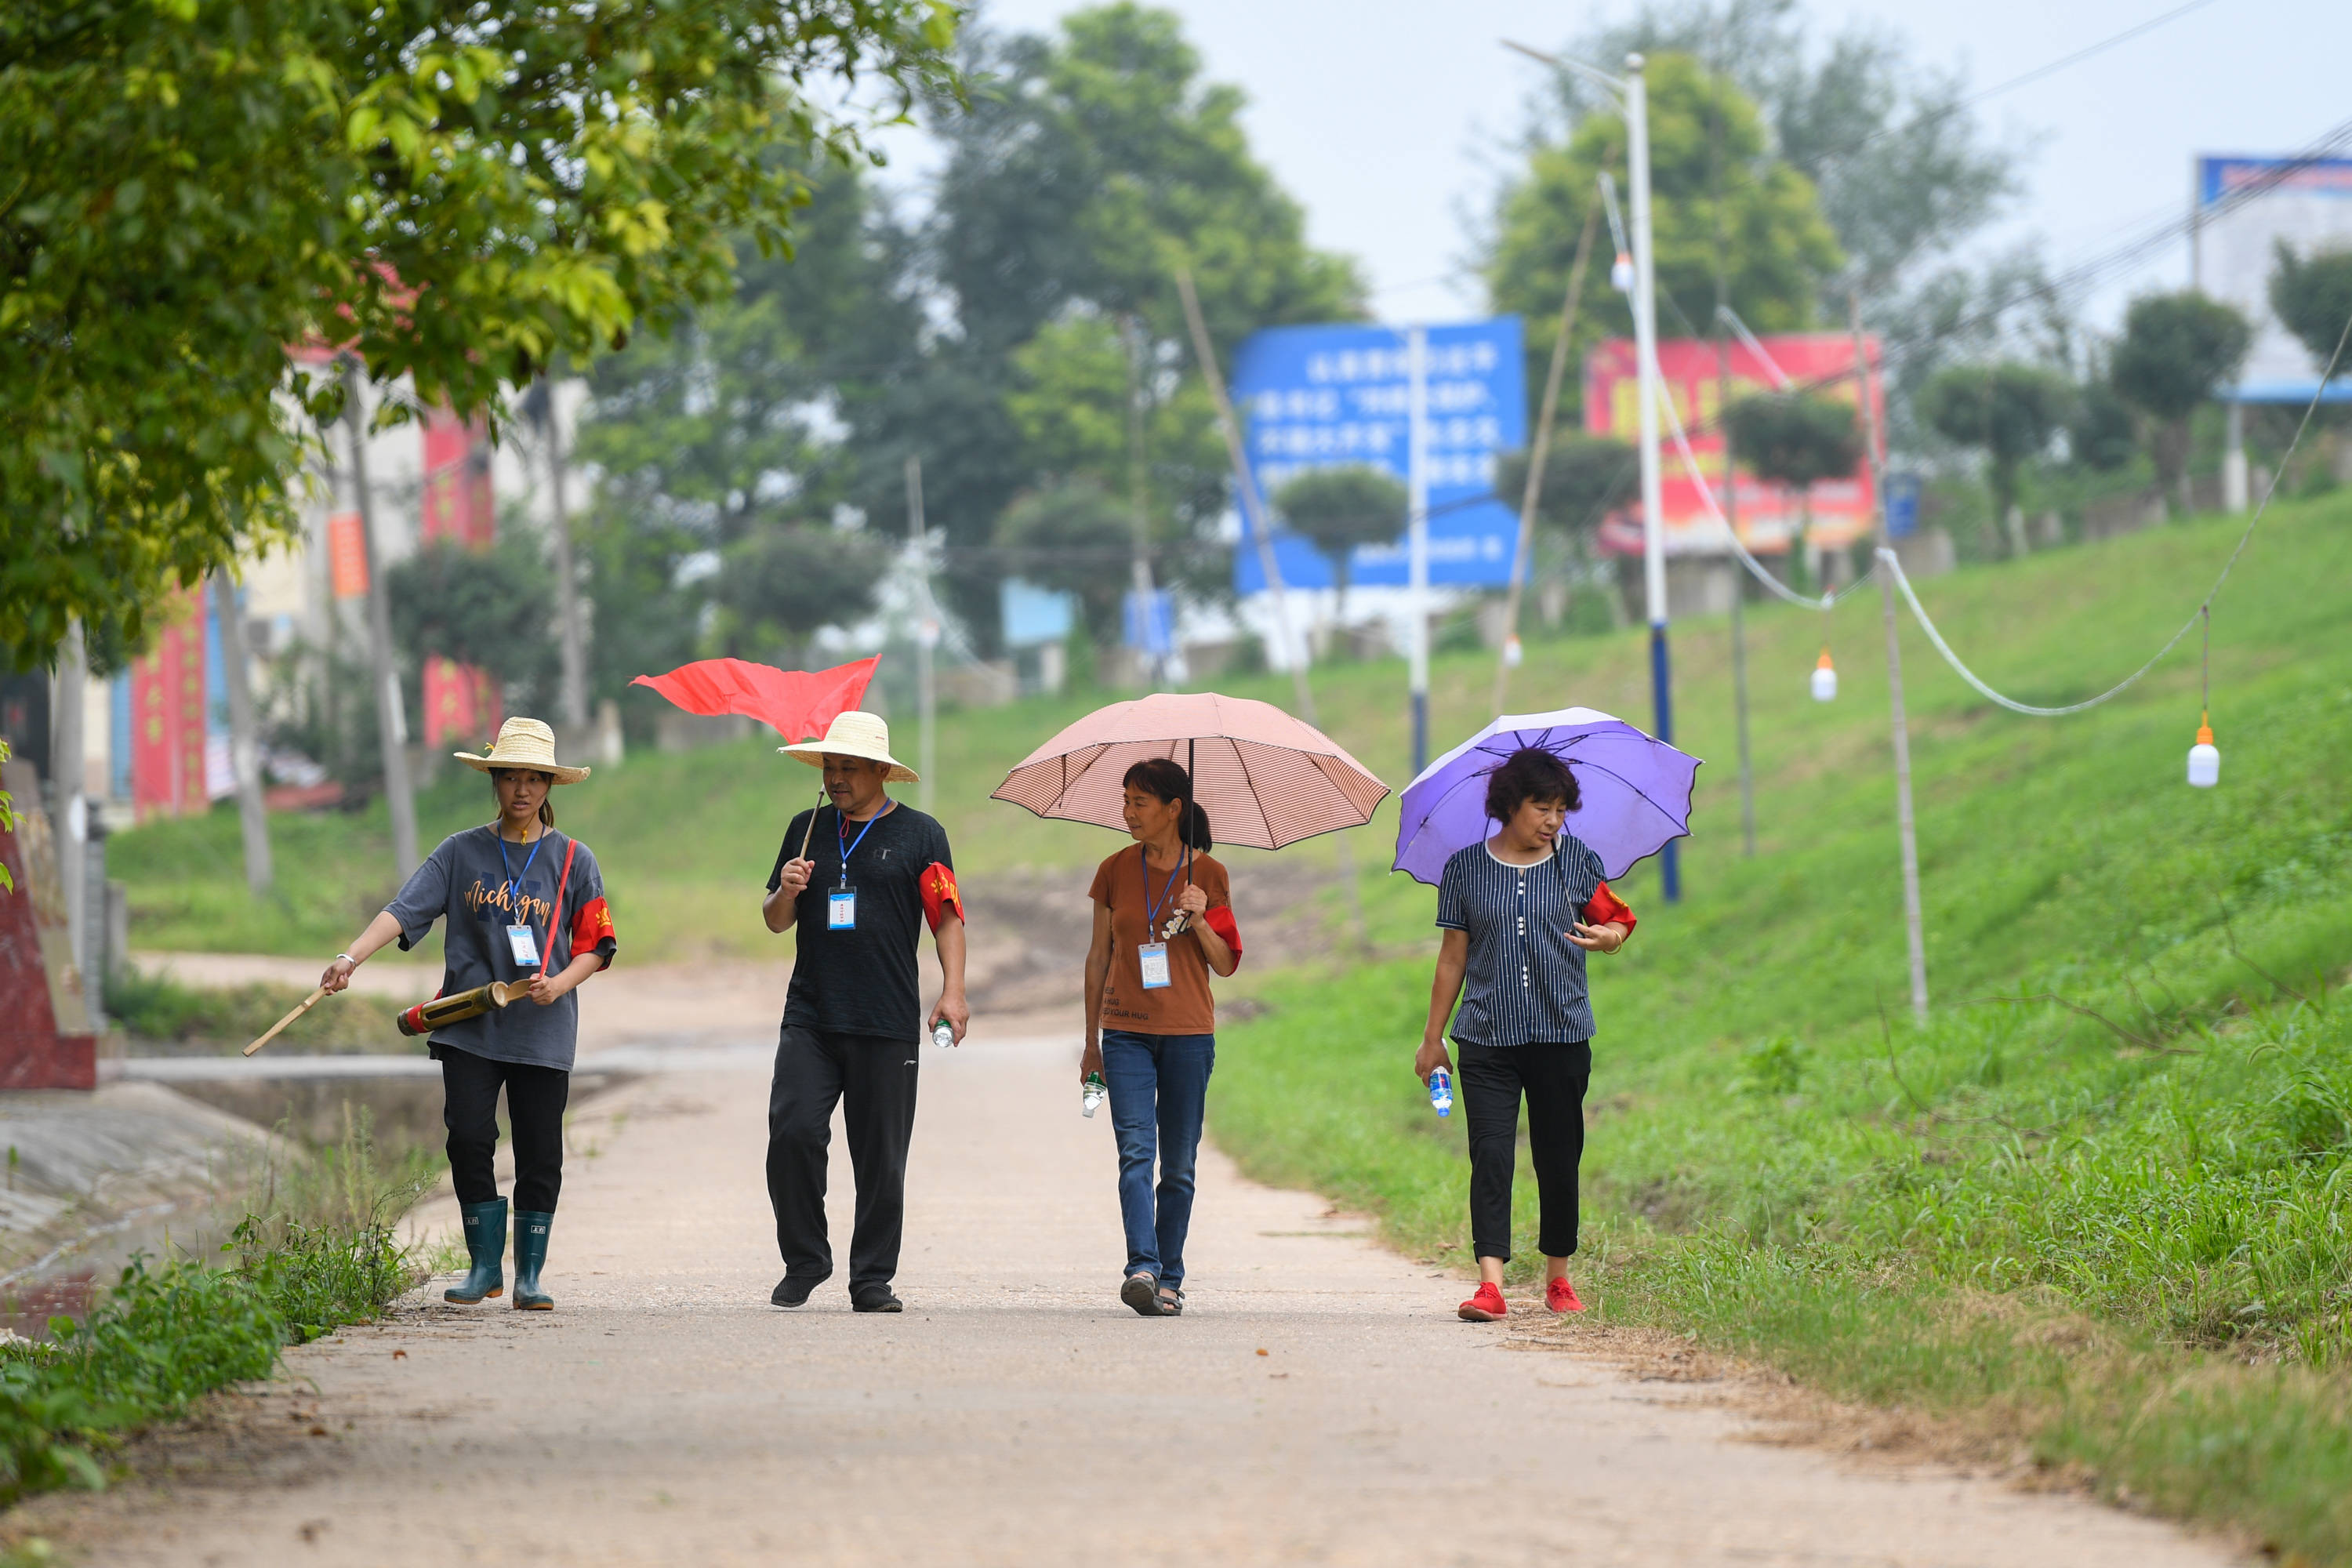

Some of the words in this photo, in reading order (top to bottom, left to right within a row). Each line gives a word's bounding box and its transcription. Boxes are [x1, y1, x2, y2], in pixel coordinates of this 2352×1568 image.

[464, 880, 551, 927] Michigan
[1110, 1008, 1129, 1017] YOUR
[1131, 1011, 1149, 1020] HUG
